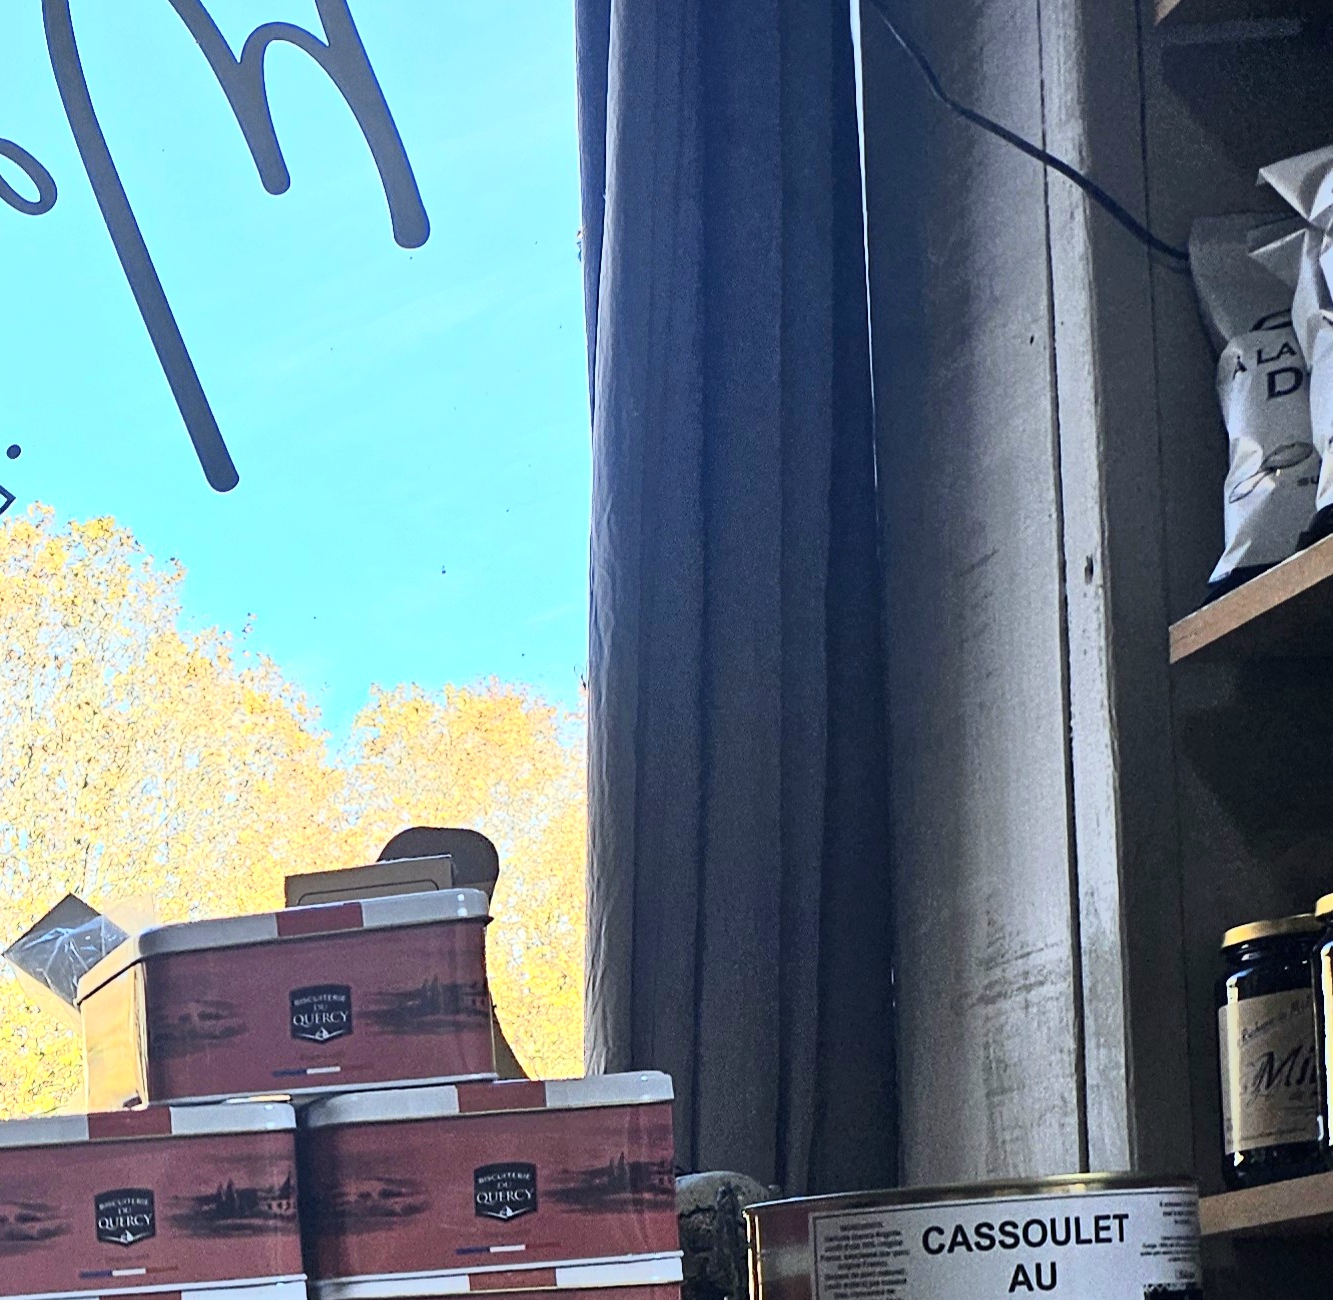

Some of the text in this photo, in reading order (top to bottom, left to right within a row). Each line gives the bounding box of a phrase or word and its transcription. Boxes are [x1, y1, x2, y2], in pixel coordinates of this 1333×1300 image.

[293, 1009, 348, 1026] QUERCY
[478, 1172, 532, 1183] BISCUITERIE
[477, 1188, 533, 1205] QUERCY
[98, 1213, 152, 1231] QUERCY
[922, 1212, 1129, 1255] CASSOULET
[1009, 1262, 1057, 1293] AU
